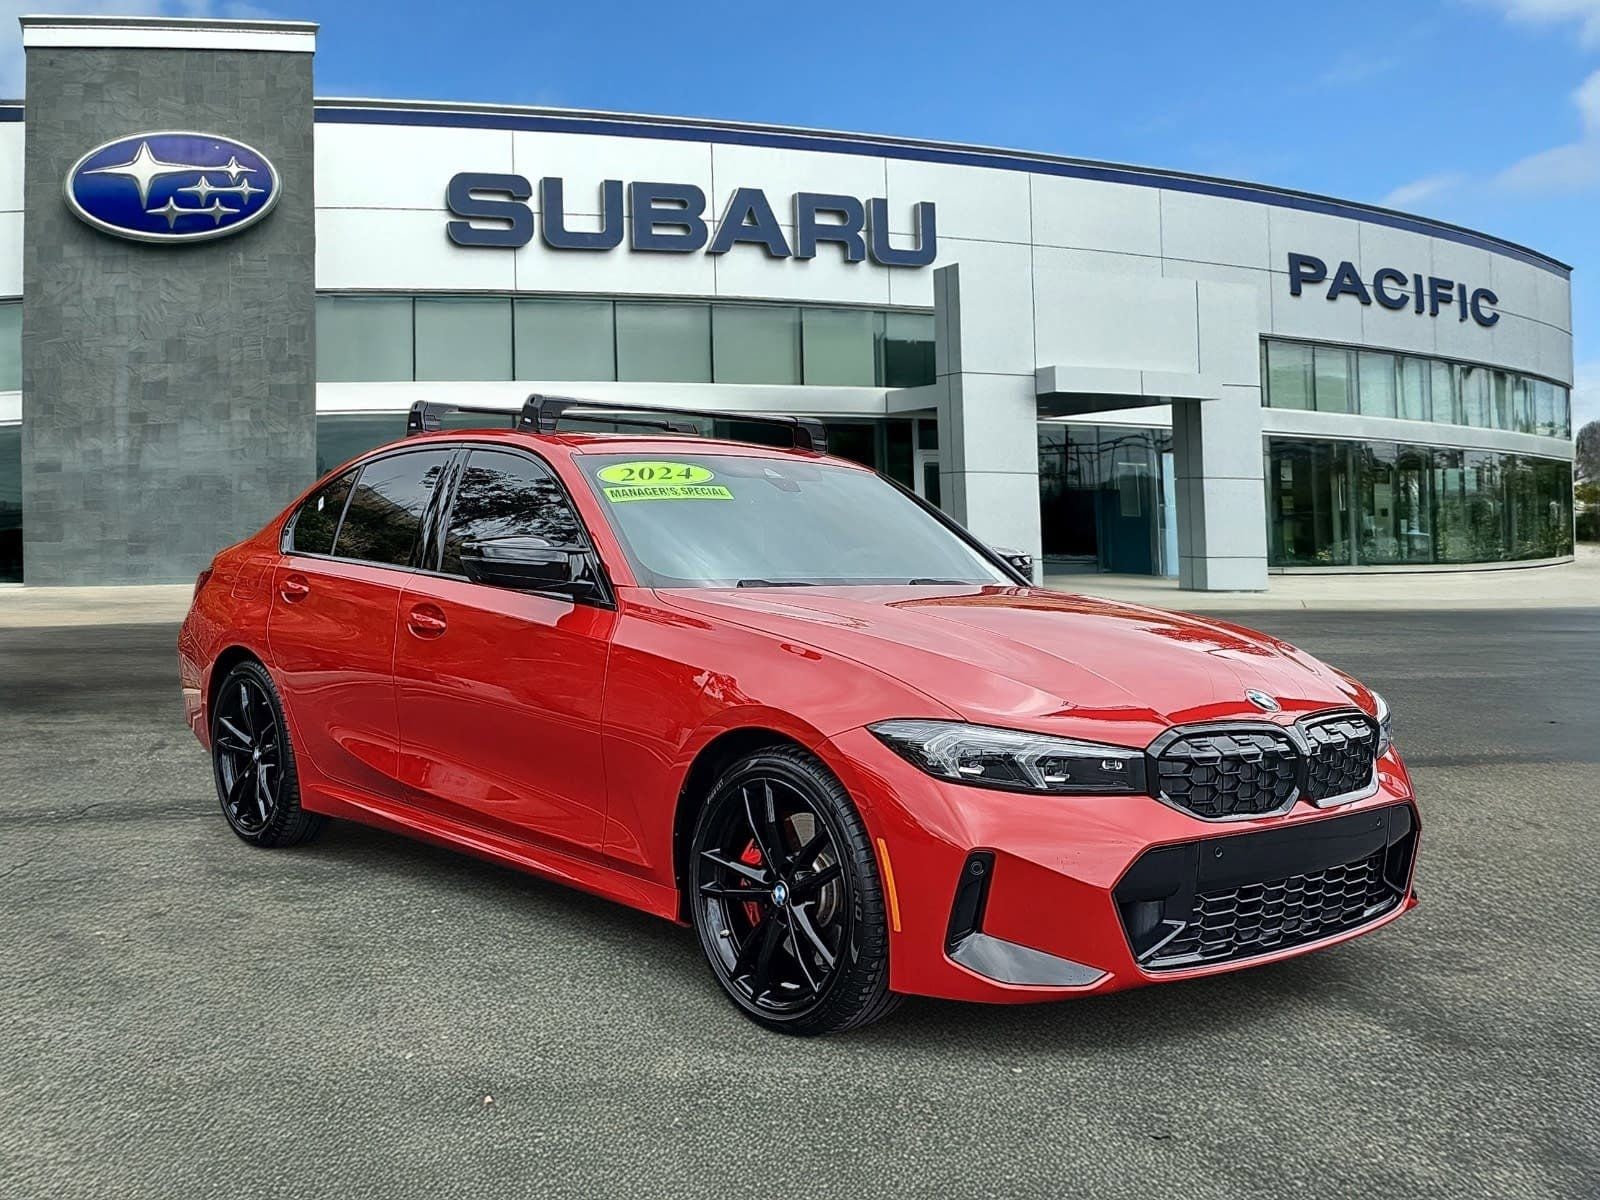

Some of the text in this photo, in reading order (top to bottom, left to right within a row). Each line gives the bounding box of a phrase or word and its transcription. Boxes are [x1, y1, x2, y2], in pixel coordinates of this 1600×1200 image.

[446, 172, 937, 267] SUBARU
[1288, 252, 1500, 327] PACIFIC
[609, 486, 727, 498] MANAGER'S SPECIAL
[621, 467, 693, 481] 2024
